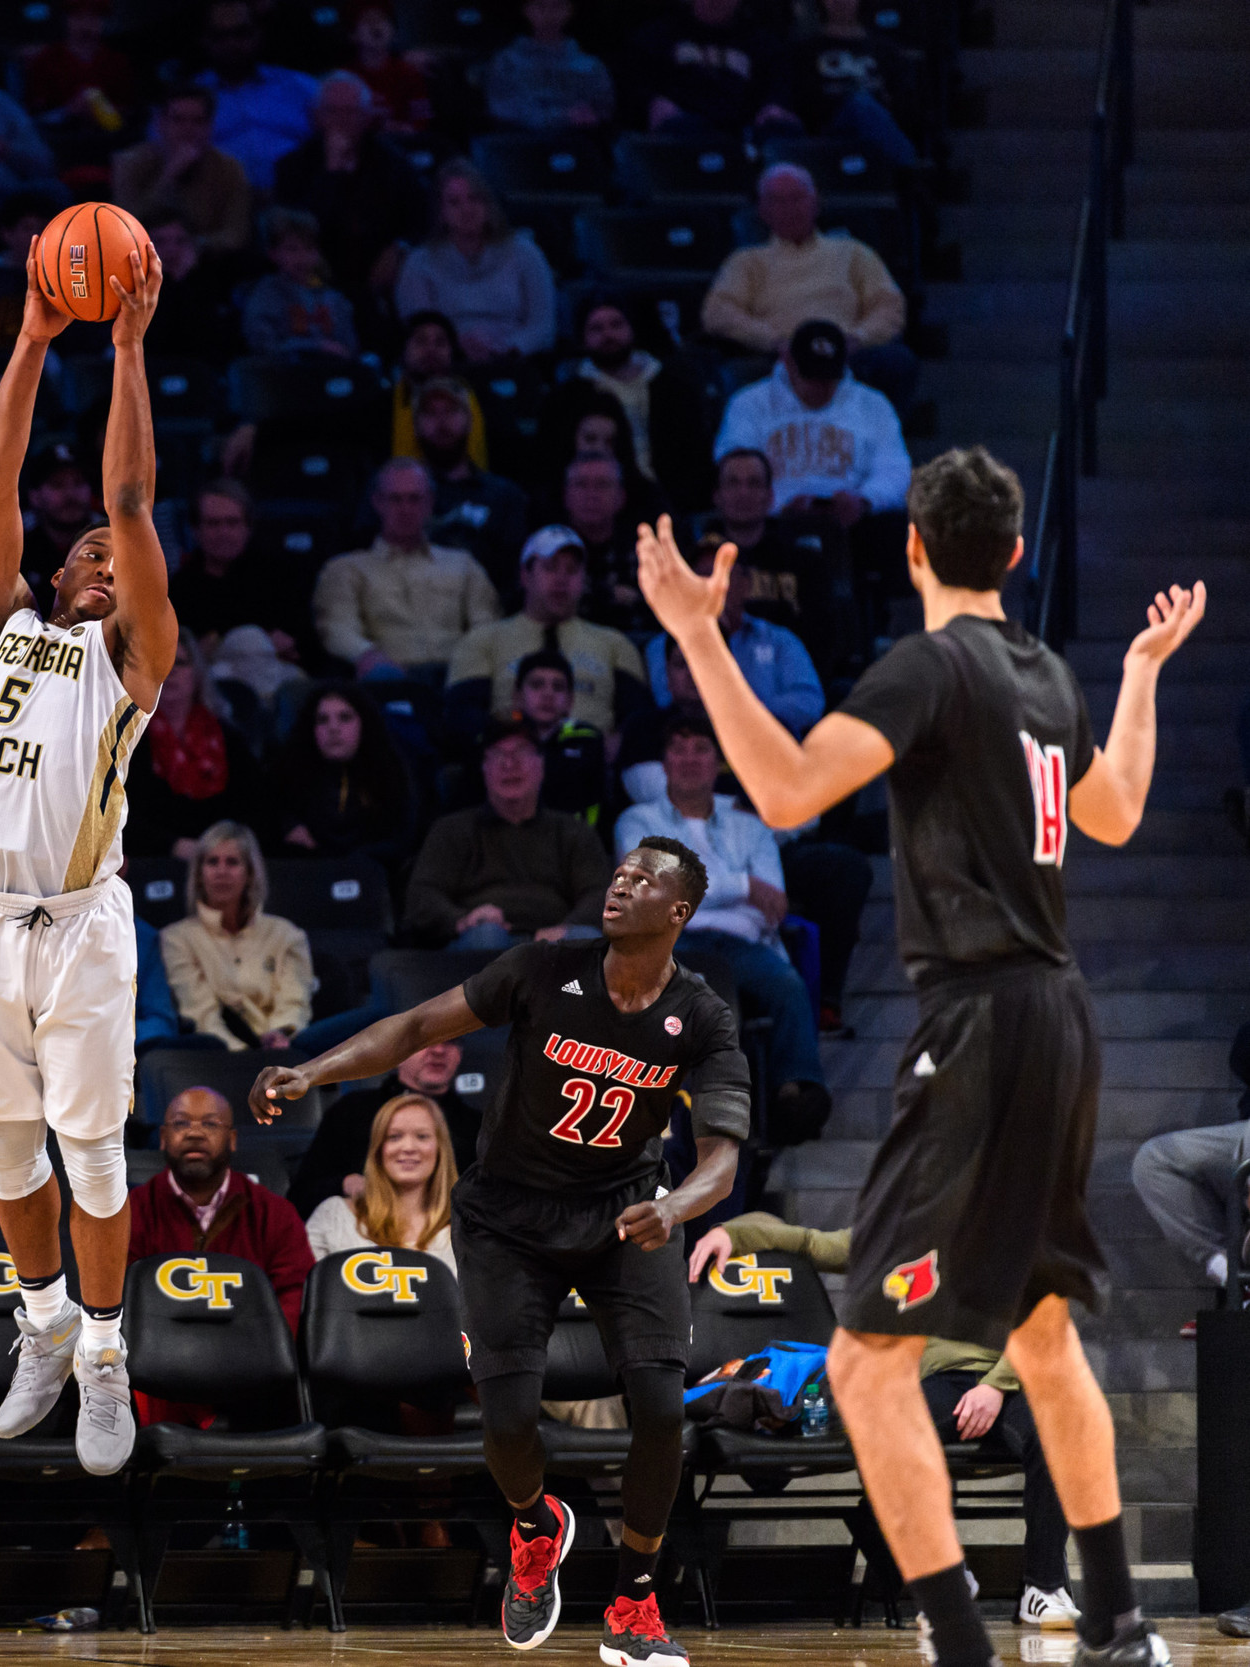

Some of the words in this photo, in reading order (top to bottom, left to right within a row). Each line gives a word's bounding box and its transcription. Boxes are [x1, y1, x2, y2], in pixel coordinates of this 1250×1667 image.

[69, 244, 88, 299] ELITE
[543, 1033, 679, 1088] LOUISVILLE
[549, 1078, 636, 1147] 22
[156, 1257, 243, 1309] GT
[341, 1252, 427, 1303] GT
[709, 1253, 792, 1304] GT
